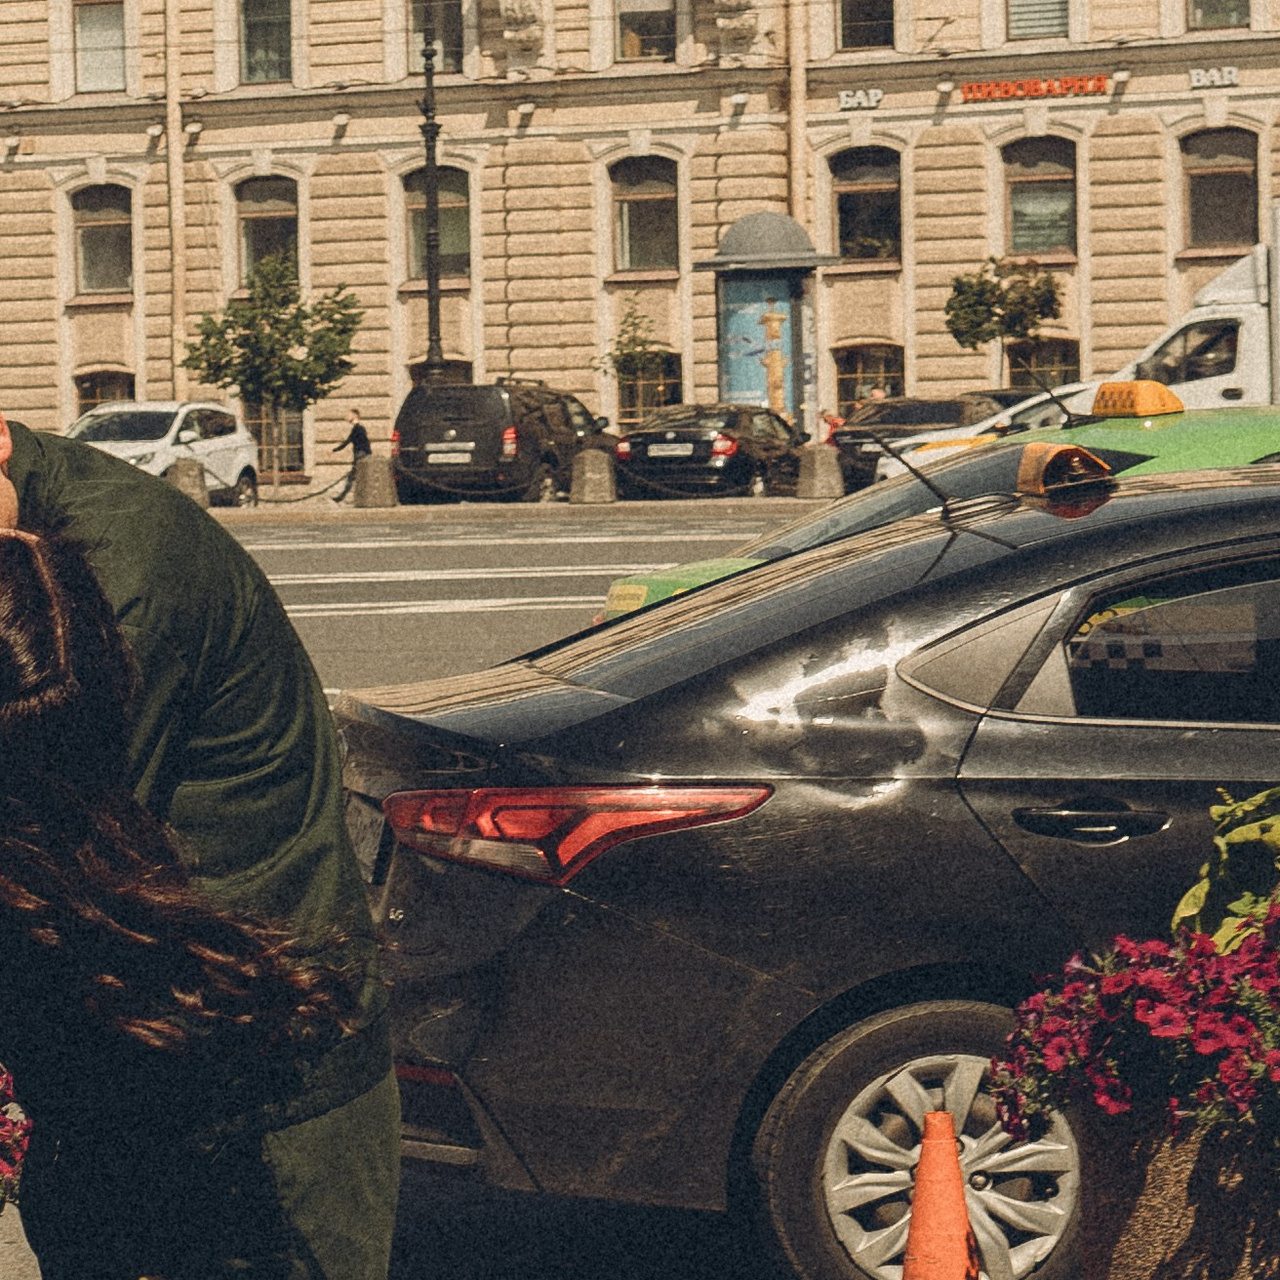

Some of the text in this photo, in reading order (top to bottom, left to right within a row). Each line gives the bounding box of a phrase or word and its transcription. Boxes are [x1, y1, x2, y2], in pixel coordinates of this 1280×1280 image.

[1189, 66, 1239, 87] BAR
[961, 74, 1108, 102] ПИВОВАРНЯ
[838, 89, 883, 110] БАР
